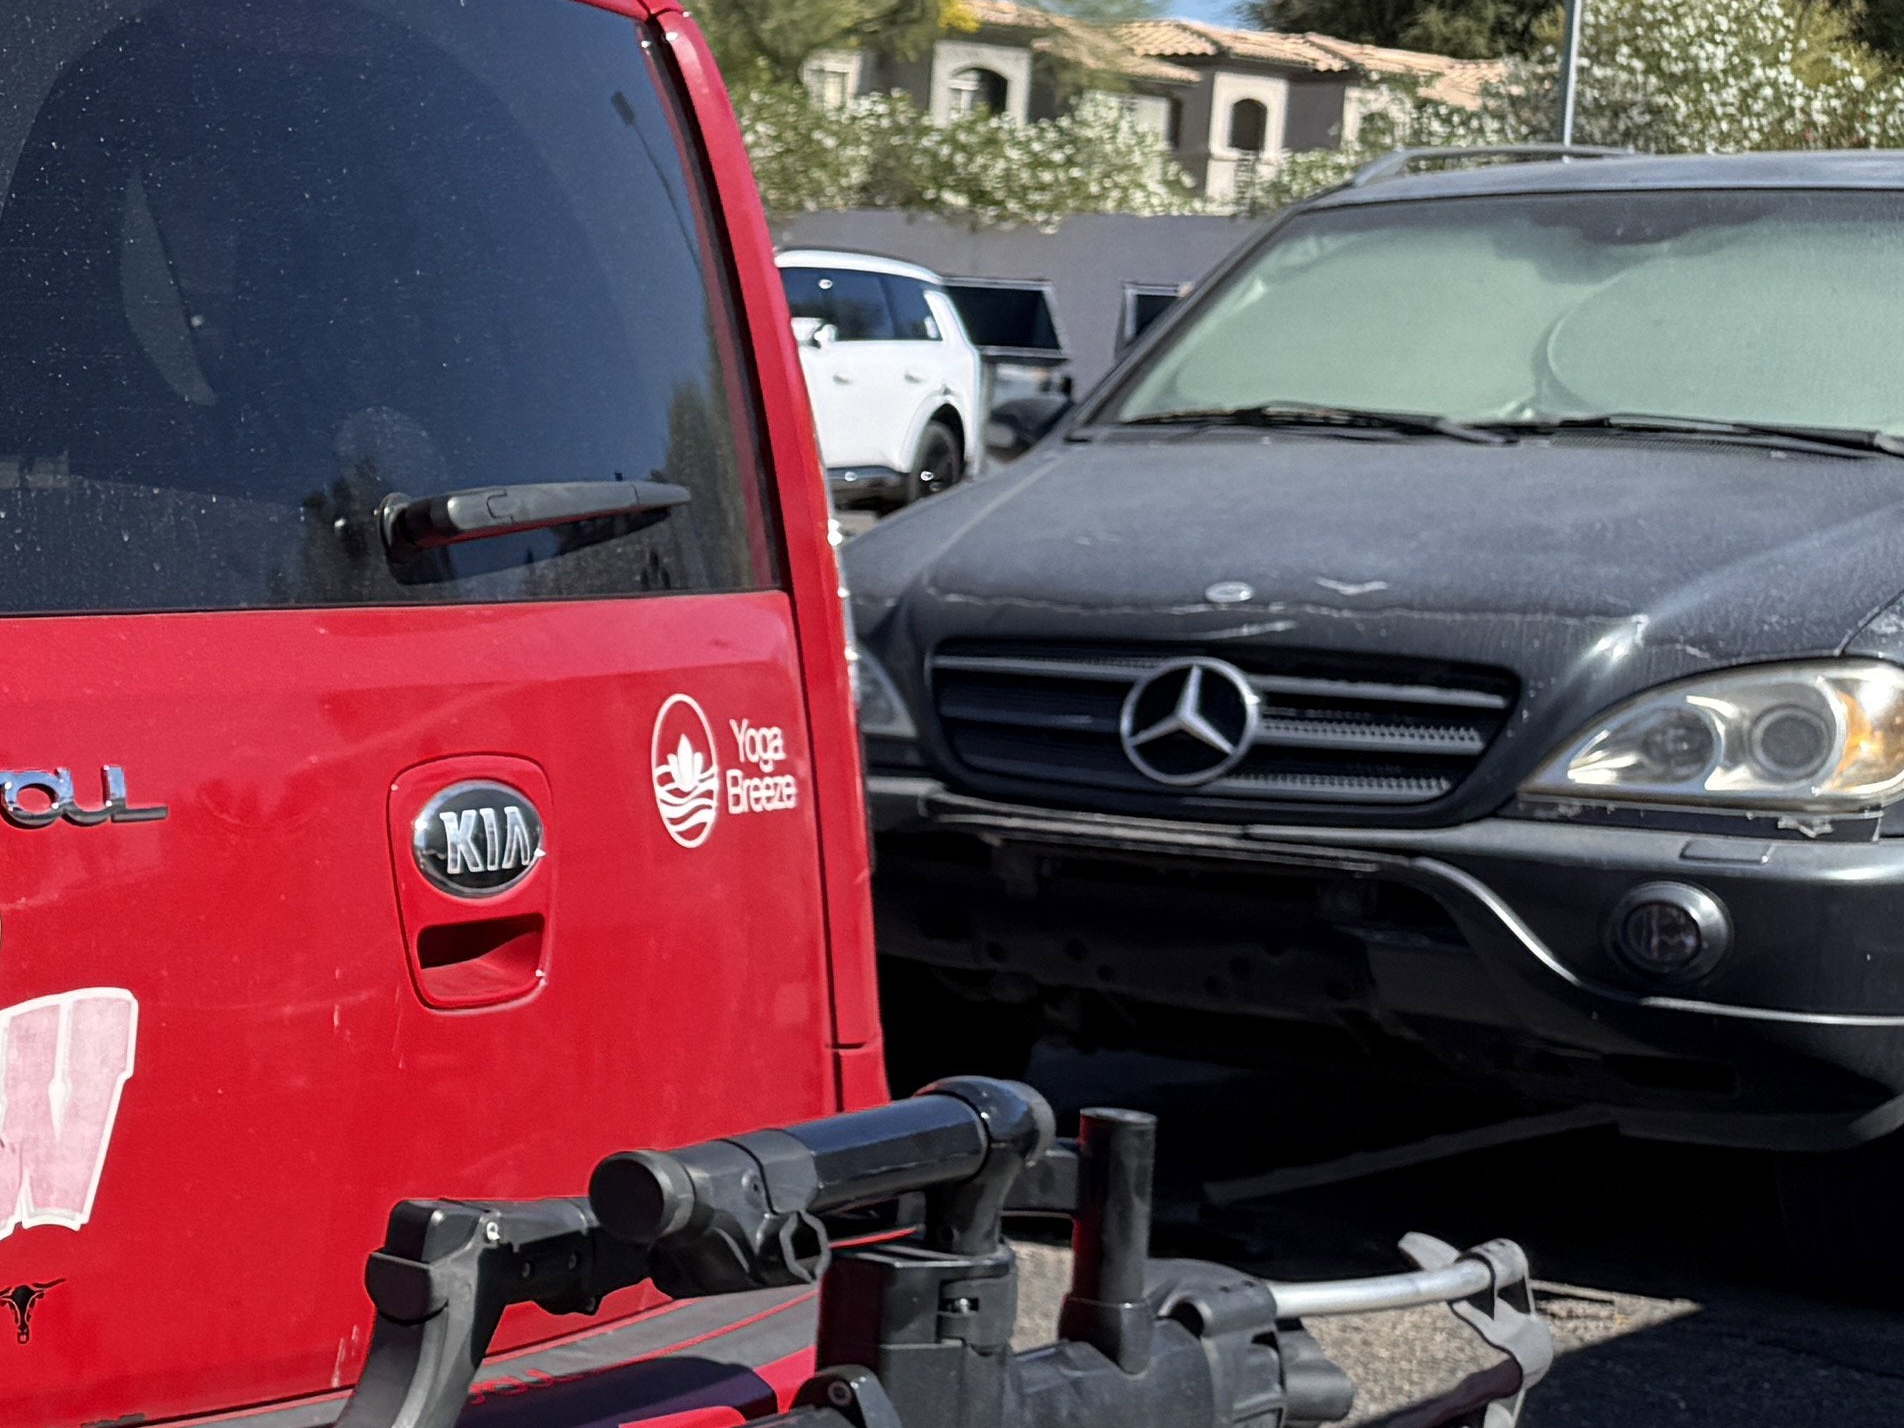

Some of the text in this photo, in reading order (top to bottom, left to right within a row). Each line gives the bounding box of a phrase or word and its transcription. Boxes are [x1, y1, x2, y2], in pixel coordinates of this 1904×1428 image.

[729, 718, 787, 773] Yoga
[725, 768, 798, 815] Breeze
[439, 805, 533, 875] KIA
